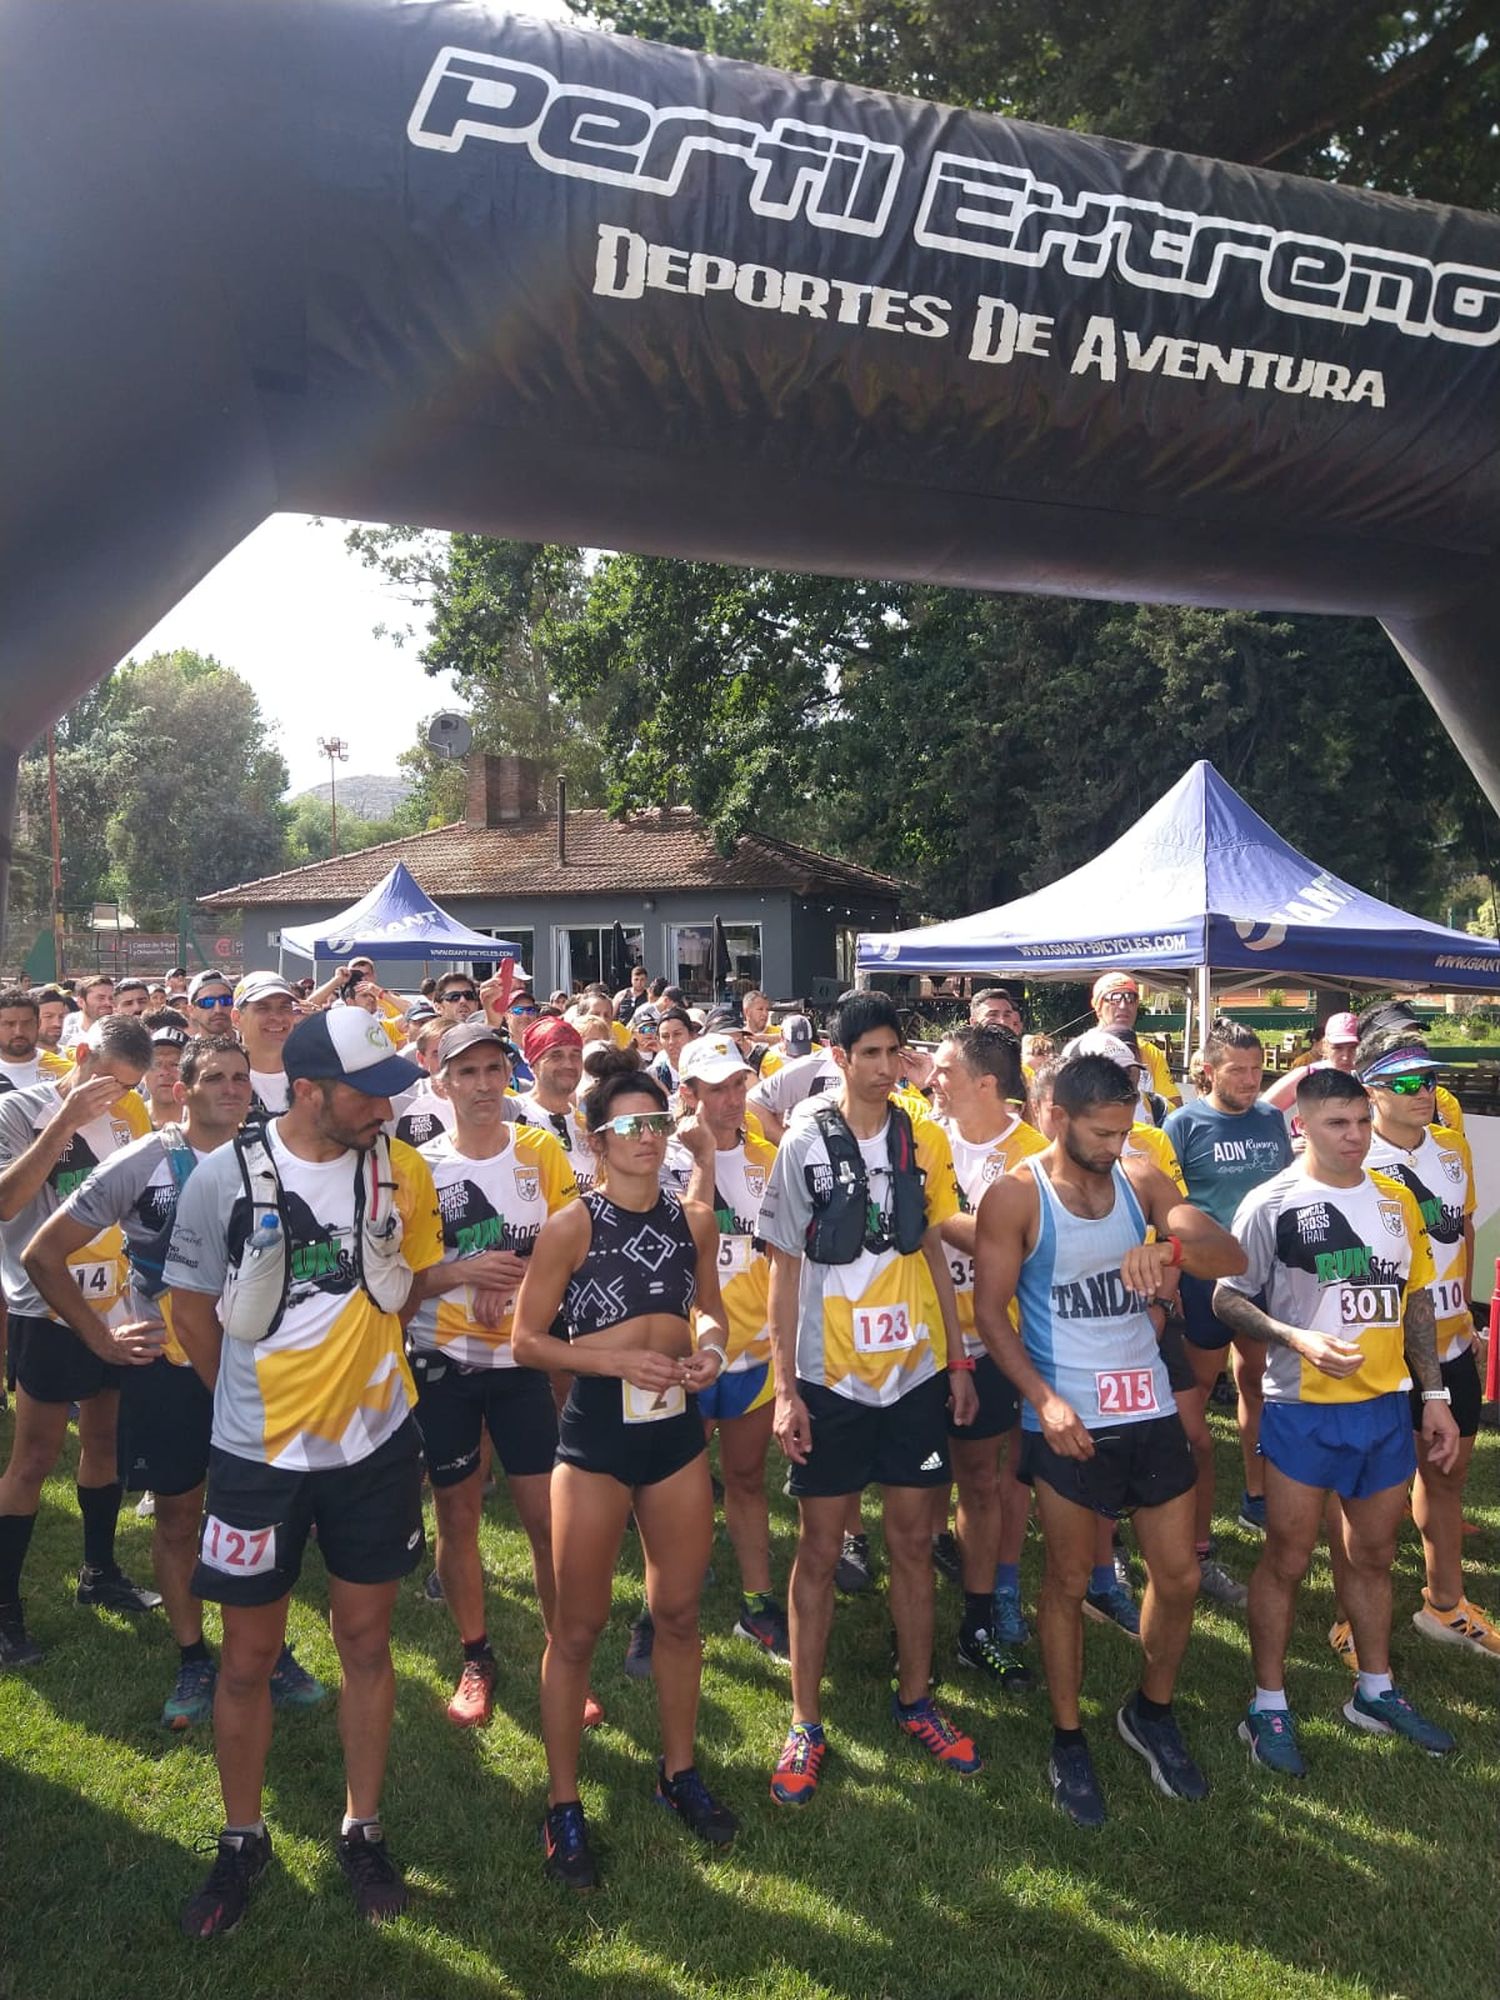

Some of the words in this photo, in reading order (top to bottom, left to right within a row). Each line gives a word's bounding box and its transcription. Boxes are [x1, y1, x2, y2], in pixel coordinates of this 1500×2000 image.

[592, 223, 952, 338] DEPORTES
[1070, 316, 1386, 408] AVENTURA
[1016, 933, 1187, 957] WWW.GIANT-BICYCLES.COM
[1213, 1141, 1247, 1163] ADN
[814, 1176, 834, 1193] CRO
[455, 1213, 505, 1256] RUN
[1314, 1245, 1373, 1282] RUN
[1342, 1288, 1394, 1322] 301
[860, 1310, 909, 1345] 123
[1100, 1375, 1152, 1409] 215
[211, 1521, 272, 1567] 127
